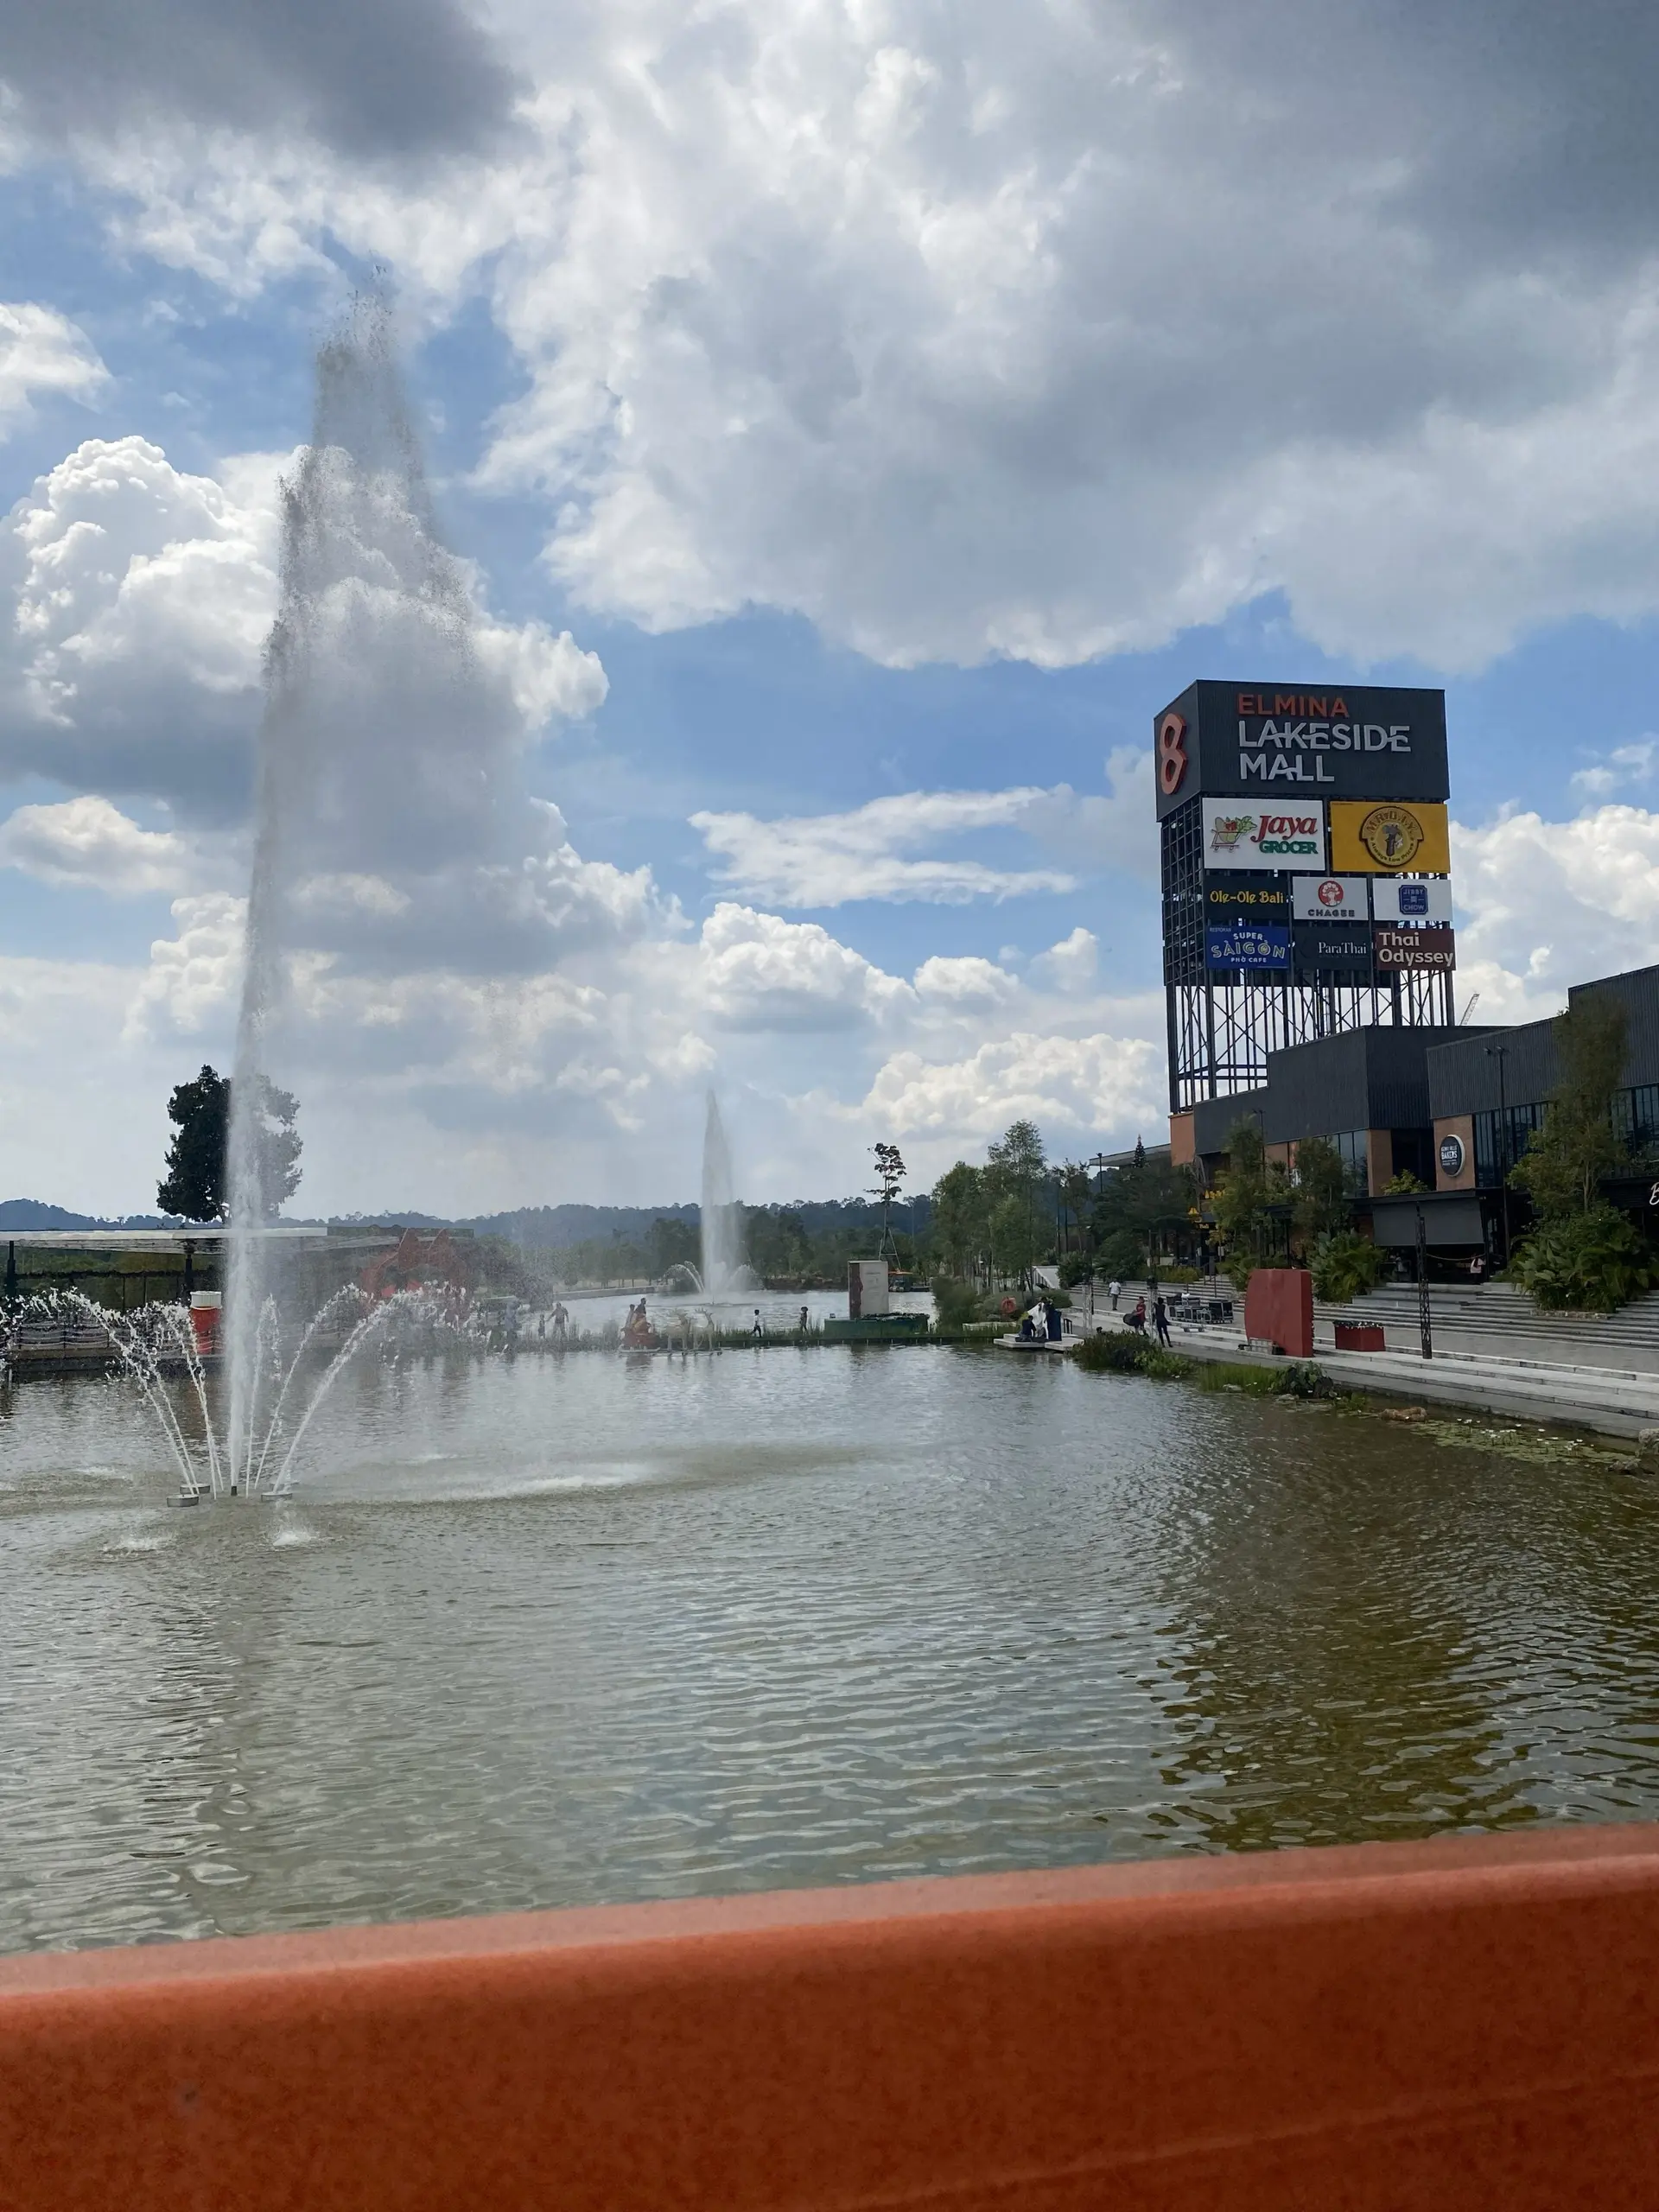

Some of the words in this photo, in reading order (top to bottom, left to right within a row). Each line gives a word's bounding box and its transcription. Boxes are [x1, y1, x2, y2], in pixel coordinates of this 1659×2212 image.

[1237, 694, 1350, 718] ELMINA
[1239, 720, 1412, 753] LAKESIDE
[1240, 753, 1335, 782] MALL
[1250, 815, 1318, 842] Jaya
[1259, 841, 1319, 855] GROCER
[1210, 891, 1256, 904] Ole-Ole
[1259, 892, 1284, 904] Bali
[1307, 909, 1355, 918] CHAGEE
[1378, 932, 1420, 947] Thai
[1378, 949, 1453, 967] Odyssey
